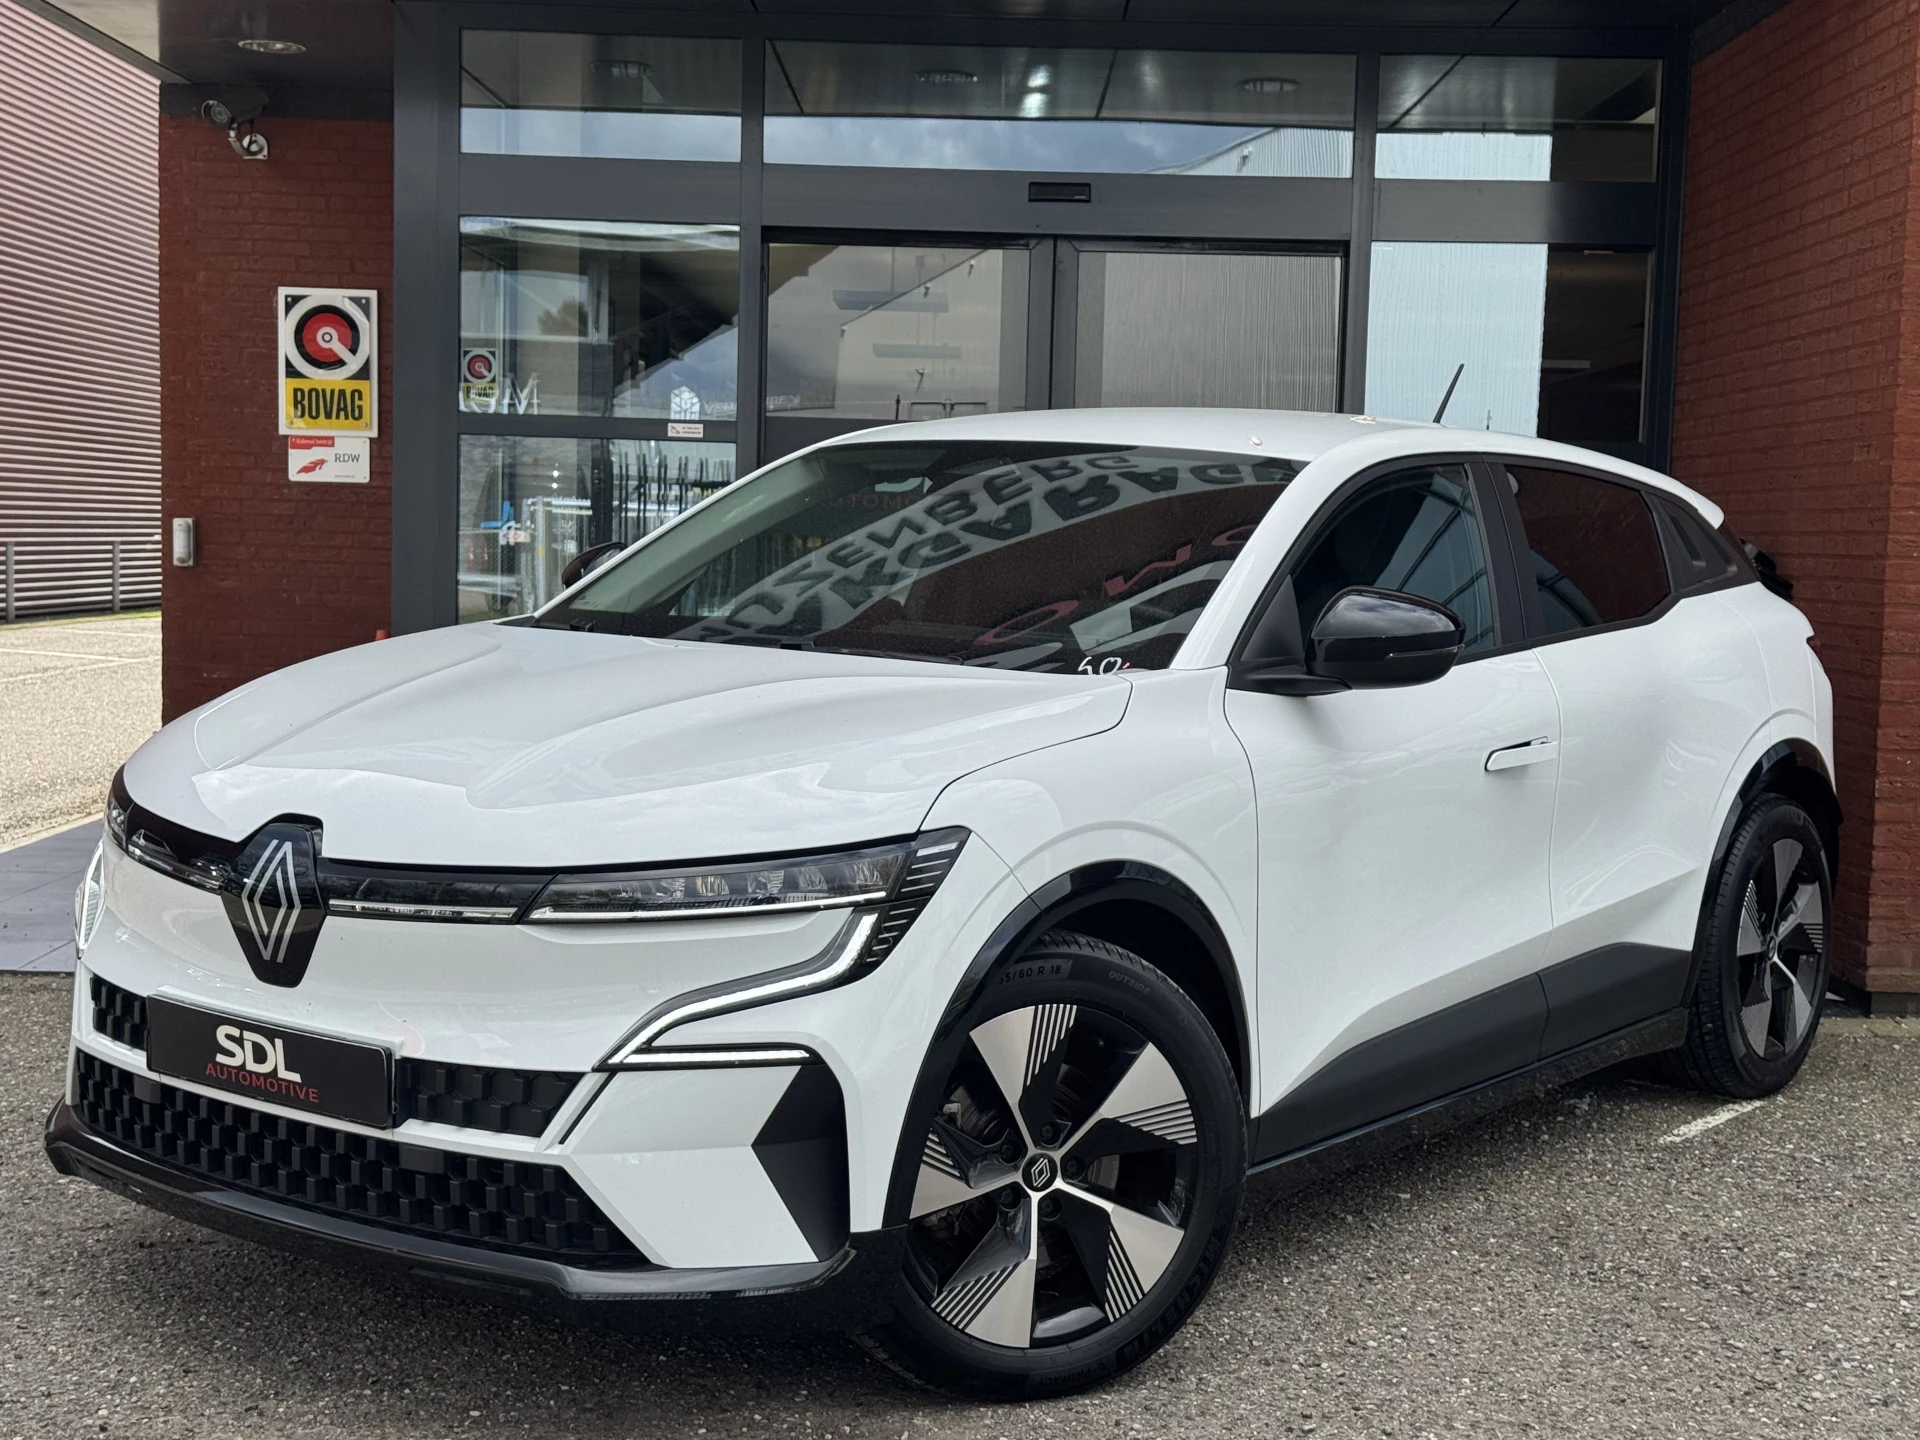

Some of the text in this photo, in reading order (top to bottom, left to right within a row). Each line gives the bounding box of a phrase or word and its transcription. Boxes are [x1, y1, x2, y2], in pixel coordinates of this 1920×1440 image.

[292, 387, 364, 421] BOVAG
[334, 453, 360, 463] RDW
[1037, 966, 1044, 975] R
[1050, 965, 1062, 974] 18
[1107, 970, 1152, 995] OUTSIDE
[215, 1024, 302, 1083] SDL
[206, 1062, 319, 1103] AUTOMOTIVE
